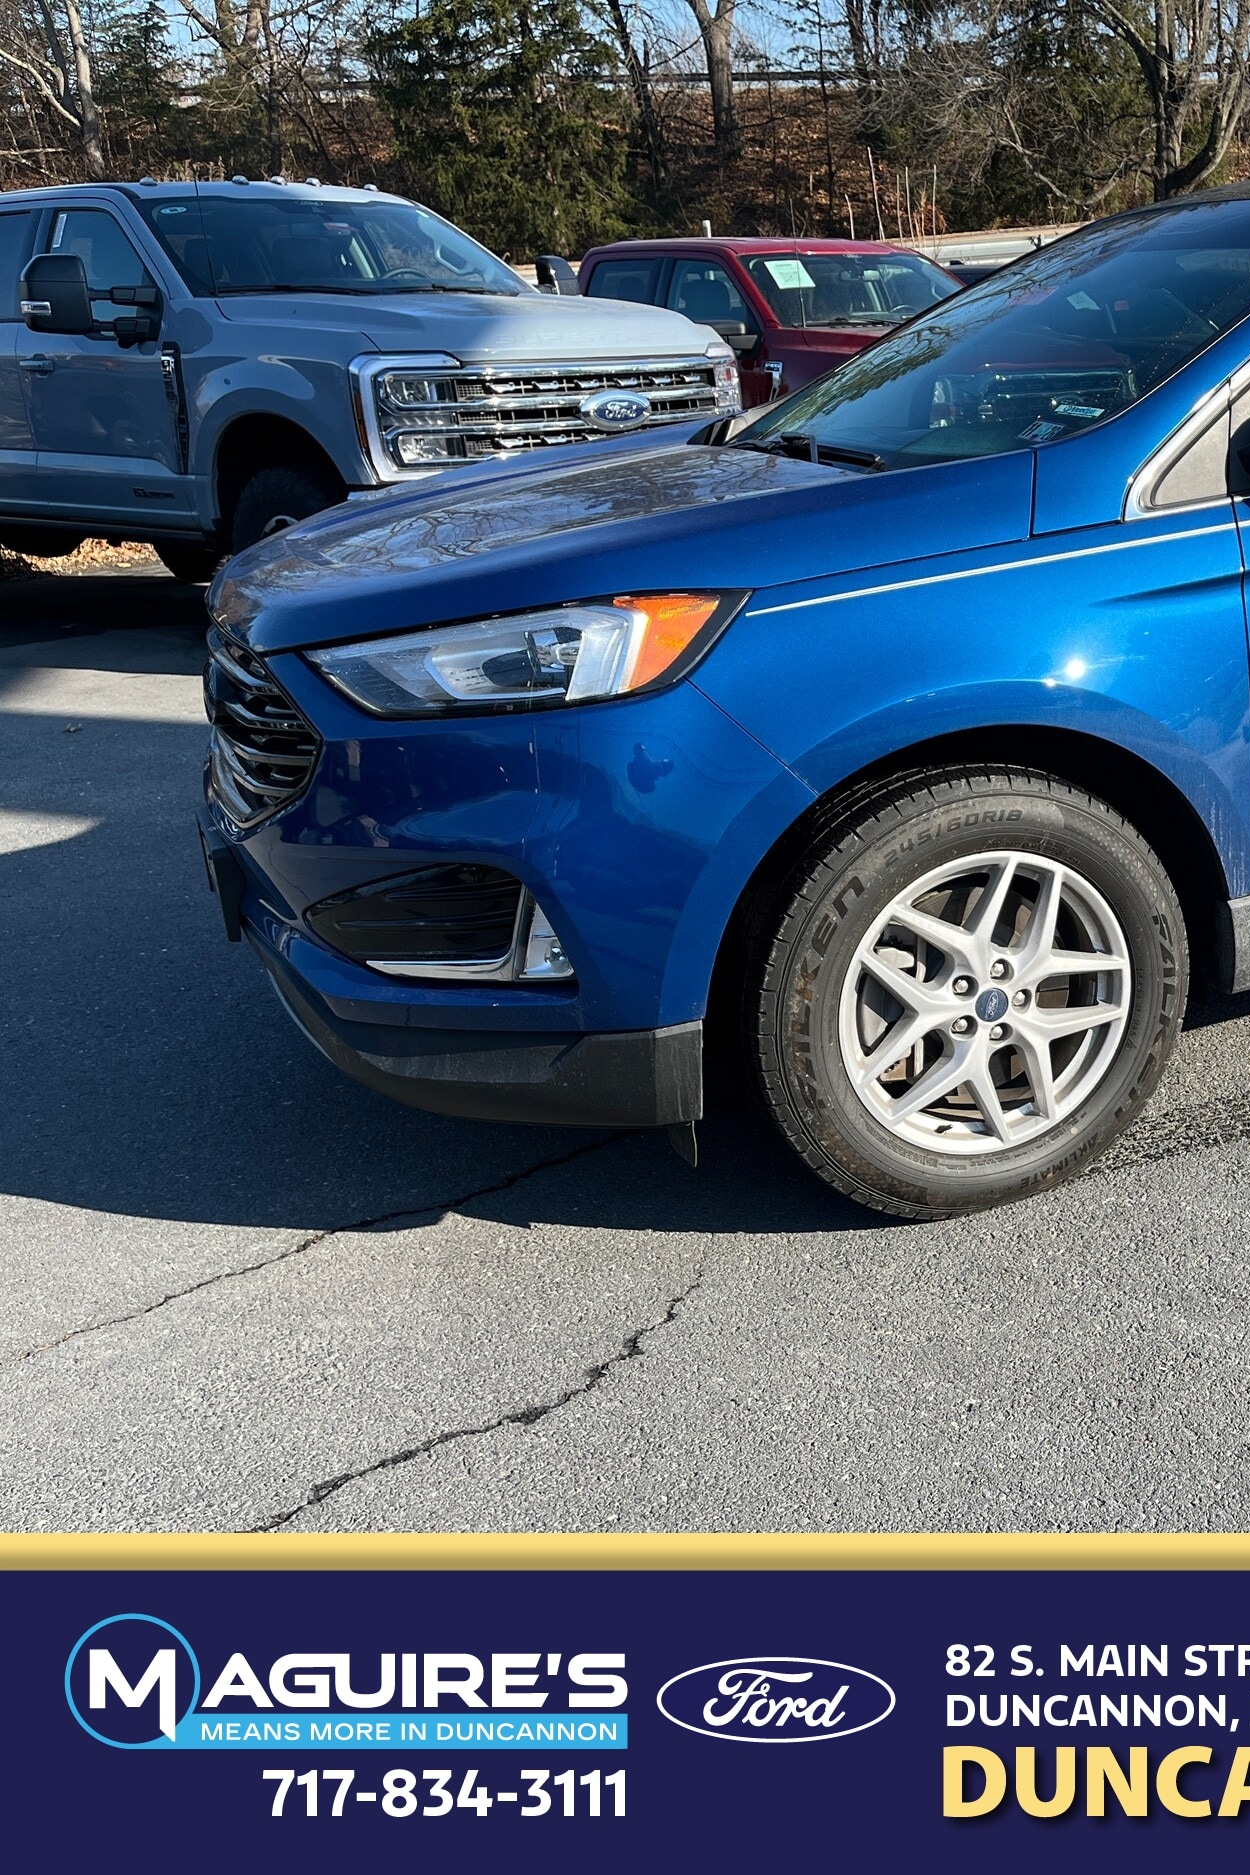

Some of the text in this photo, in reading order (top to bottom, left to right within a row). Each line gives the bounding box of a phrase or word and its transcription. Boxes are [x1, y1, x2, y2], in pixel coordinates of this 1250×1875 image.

[605, 401, 638, 419] Ford
[882, 808, 1024, 869] 245/60R18
[790, 875, 866, 1119] FALKEN
[1019, 1130, 1101, 1190] AKLIMATE
